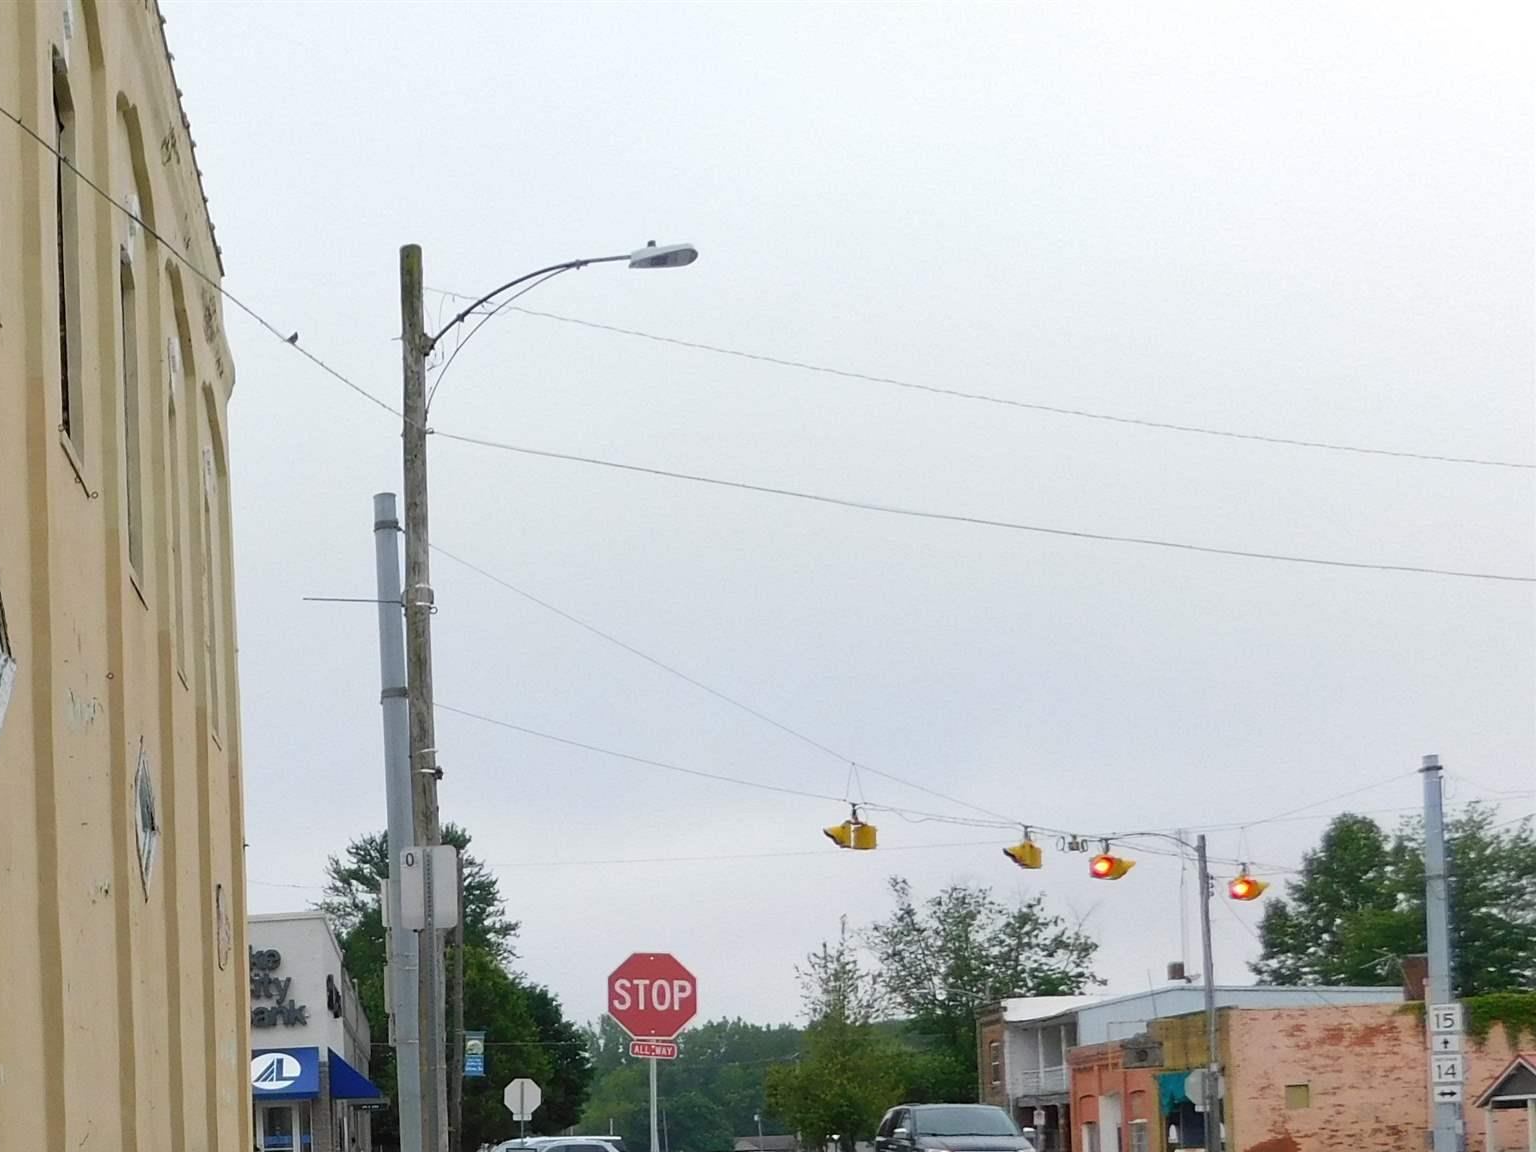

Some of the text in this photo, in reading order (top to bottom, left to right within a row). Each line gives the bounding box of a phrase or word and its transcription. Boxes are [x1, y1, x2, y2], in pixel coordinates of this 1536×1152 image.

[250, 973, 292, 1005] ity
[612, 978, 692, 1011] STOP
[250, 999, 307, 1026] ank
[1434, 1012, 1455, 1029] 15
[633, 1044, 673, 1056] ALL WAY
[1436, 1063, 1457, 1080] 14
